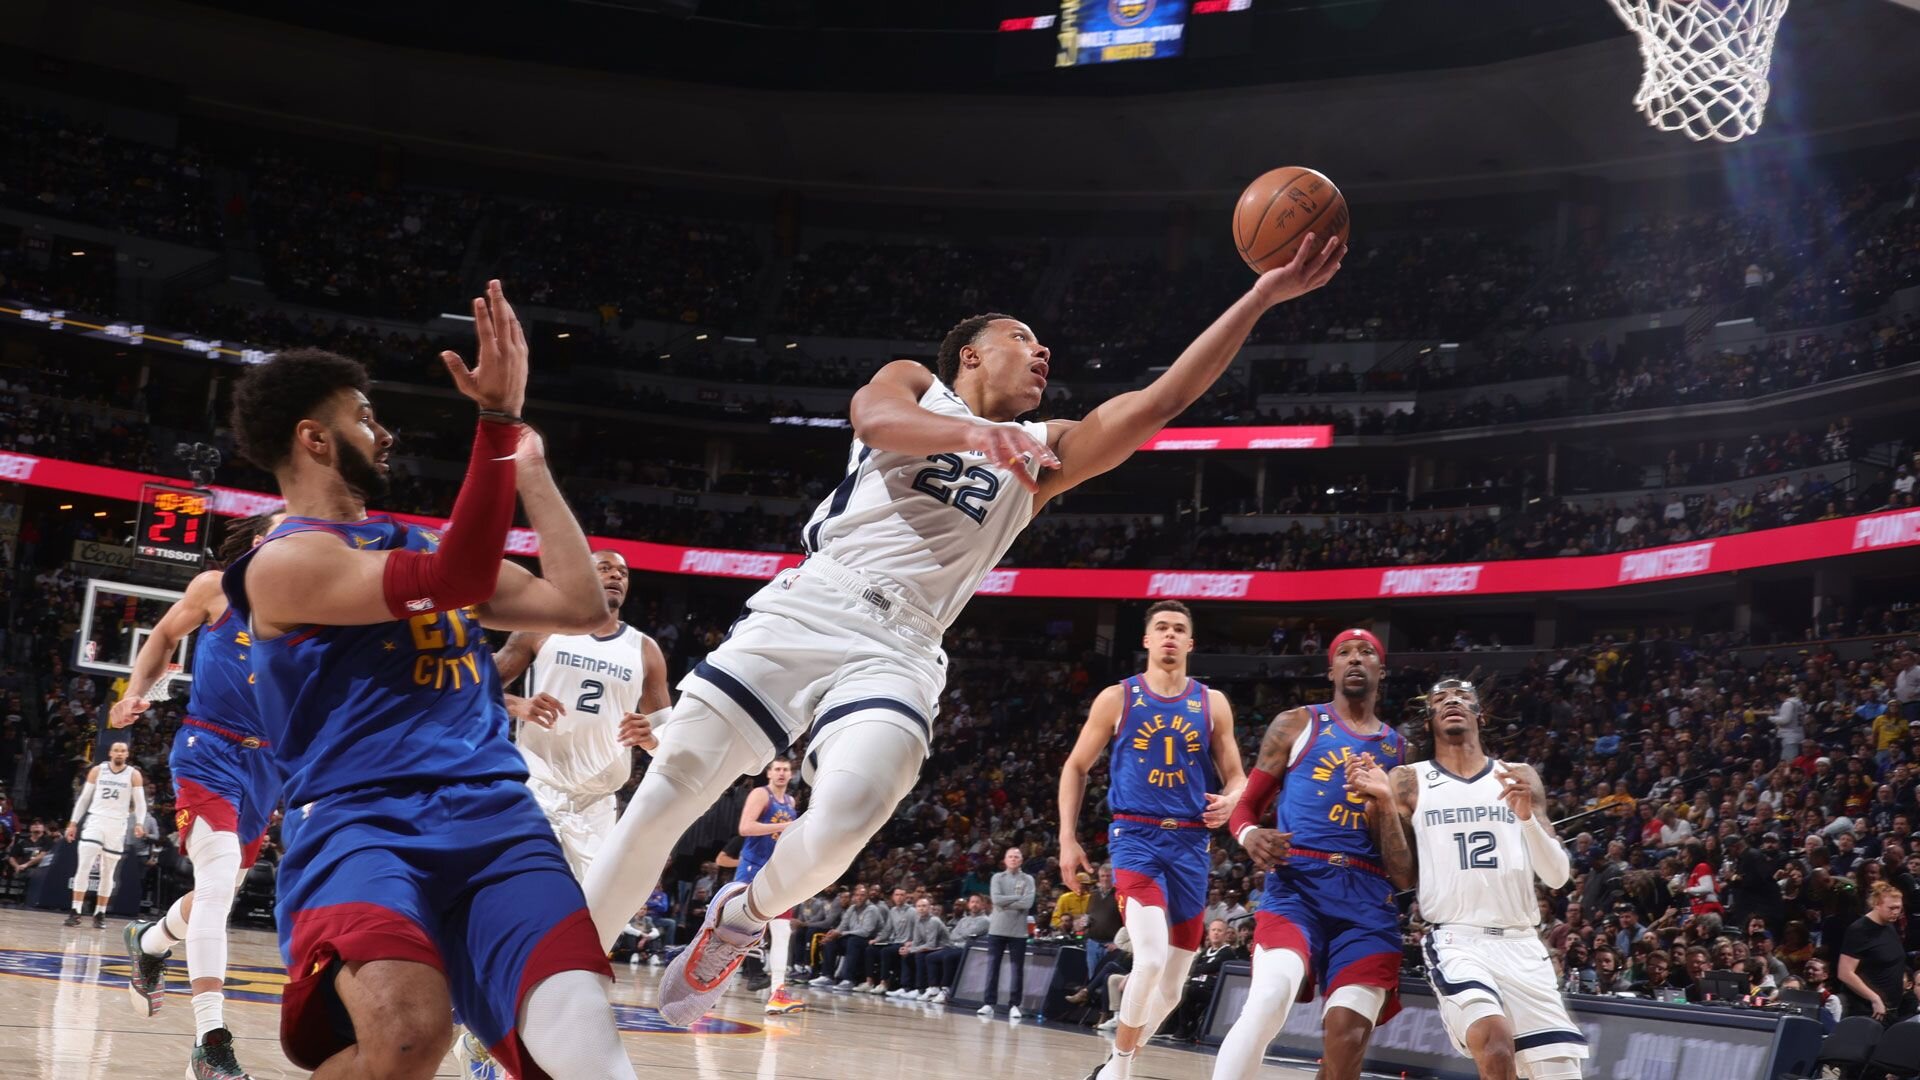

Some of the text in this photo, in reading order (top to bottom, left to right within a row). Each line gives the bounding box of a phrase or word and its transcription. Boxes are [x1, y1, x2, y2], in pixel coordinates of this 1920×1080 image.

[911, 453, 999, 525] 22
[148, 511, 199, 544] 21
[414, 651, 480, 690] CITY
[556, 650, 633, 682] MEMPHIS
[576, 678, 605, 714] 2
[1133, 714, 1201, 752] MILE HIGH
[1164, 736, 1174, 765] 1
[102, 787, 119, 800] 24
[1148, 768, 1186, 788] CITY
[1425, 806, 1516, 827] MEMPHIS
[1453, 831, 1498, 871] 12
